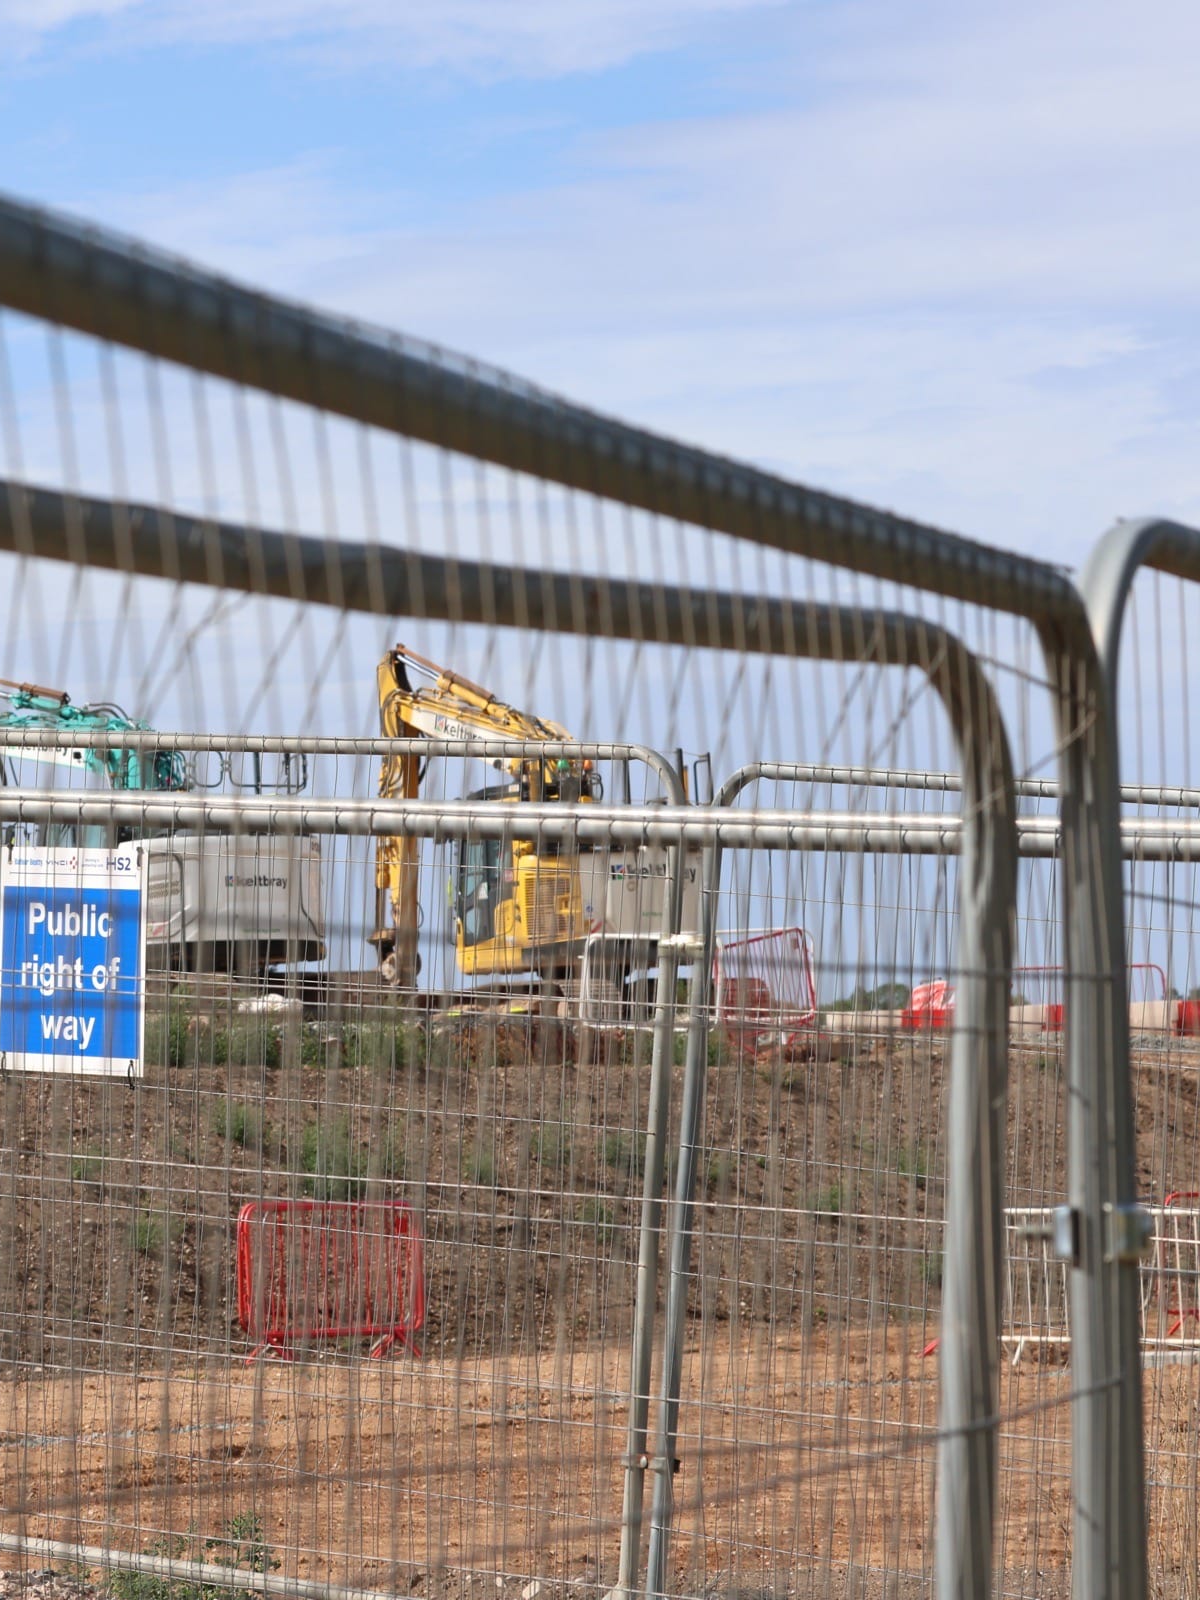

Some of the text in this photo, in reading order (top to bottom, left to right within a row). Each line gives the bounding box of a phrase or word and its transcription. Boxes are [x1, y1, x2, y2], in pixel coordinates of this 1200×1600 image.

[106, 856, 131, 871] HS2
[29, 902, 113, 937] Public
[21, 954, 120, 996] right of
[41, 1014, 95, 1050] way
